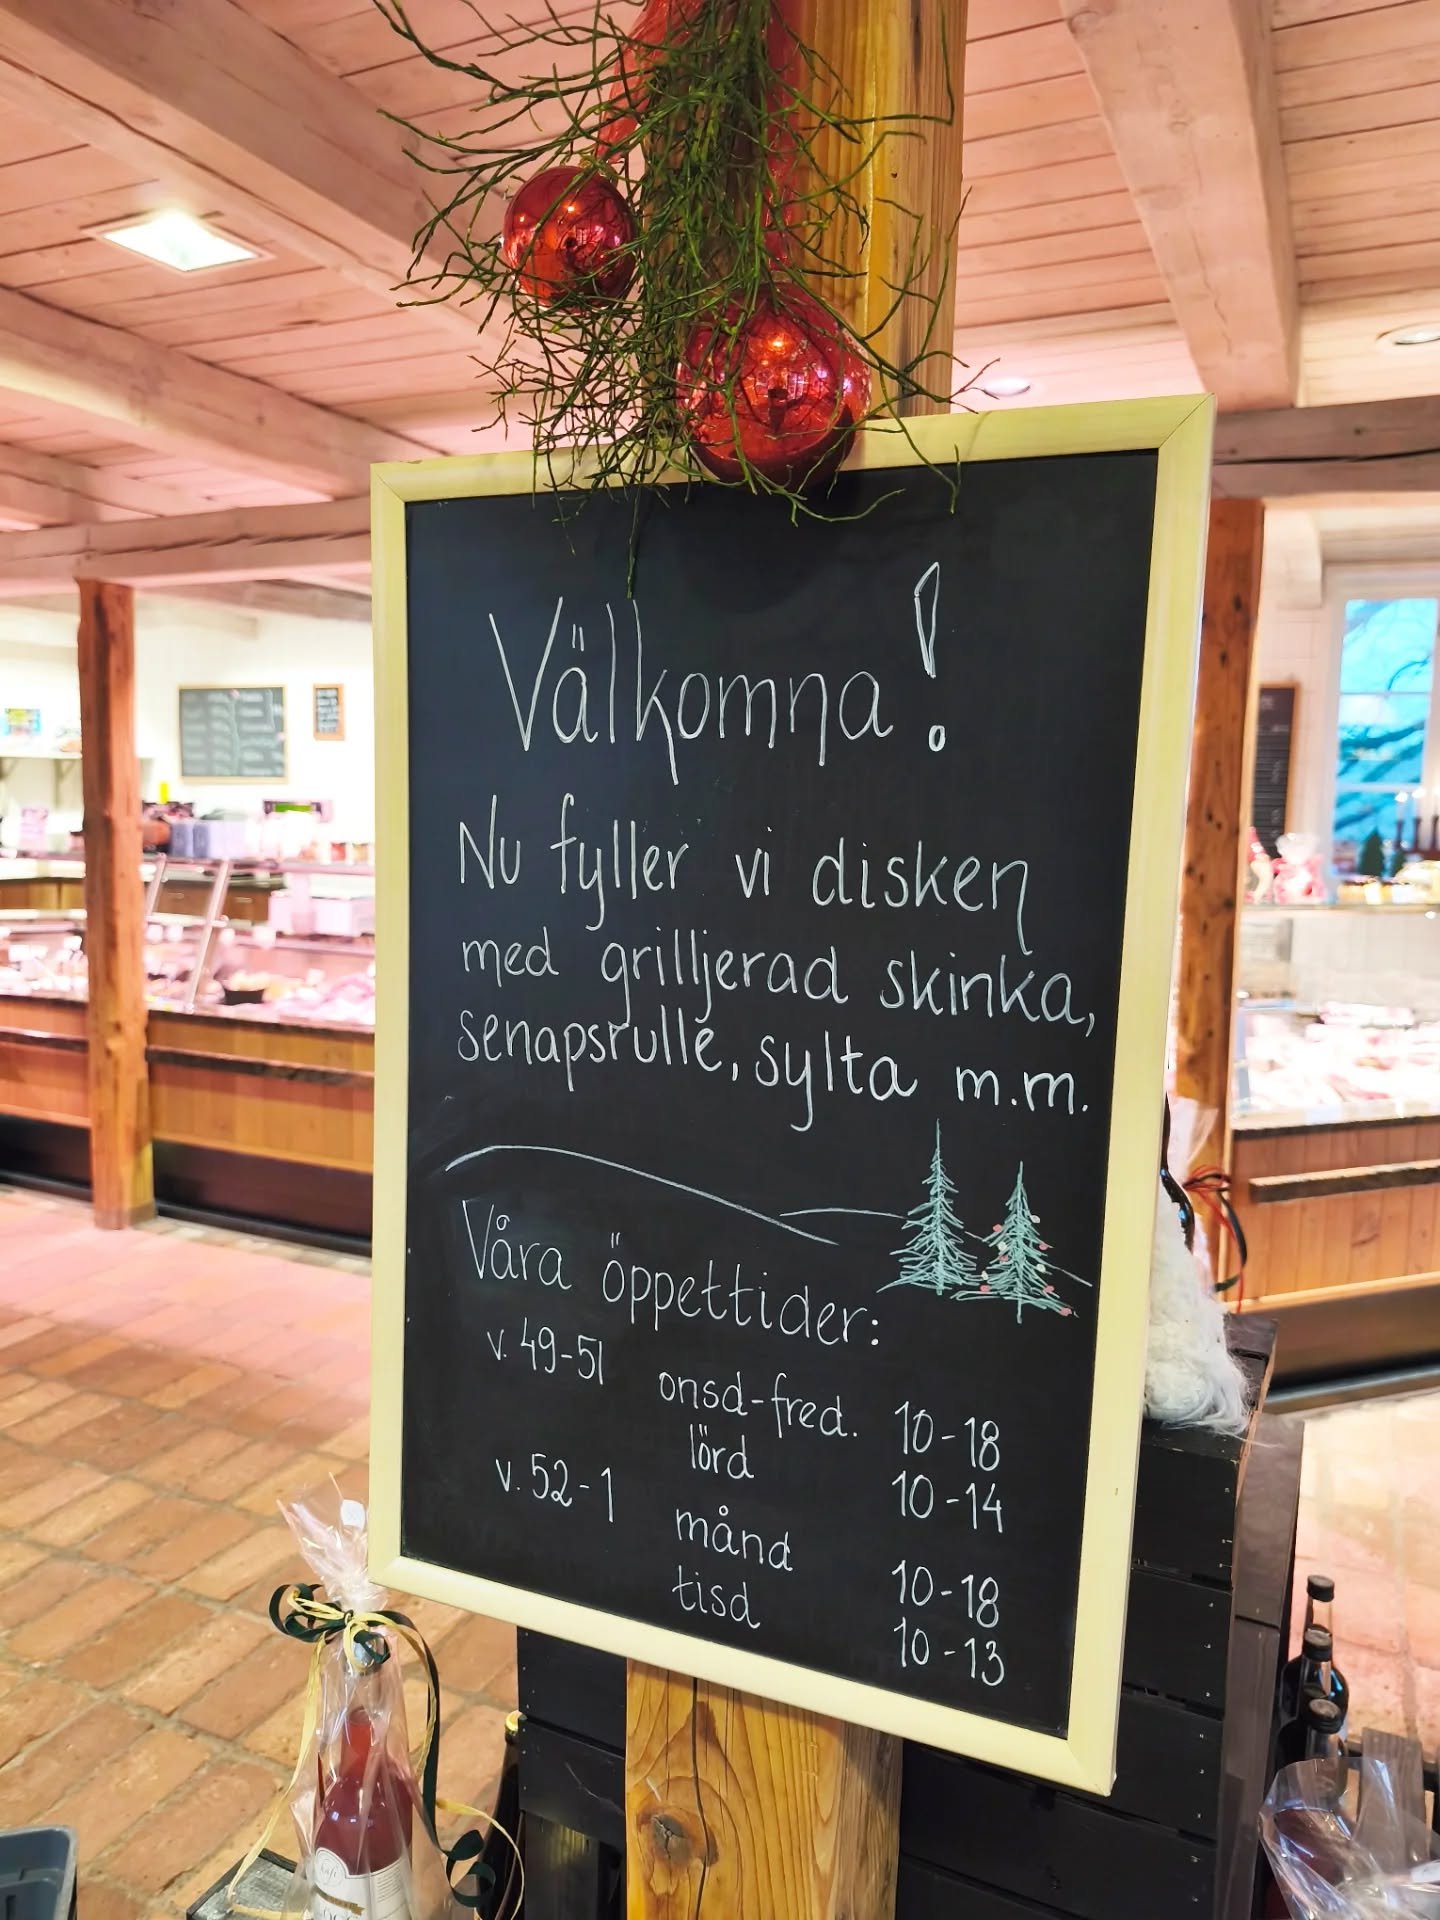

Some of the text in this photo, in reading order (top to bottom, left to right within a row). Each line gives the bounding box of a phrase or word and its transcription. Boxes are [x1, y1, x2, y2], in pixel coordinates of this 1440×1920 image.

[459, 792, 1034, 956] Nu fyller vi disken
[462, 926, 1097, 1039] med grilljerad skinka,
[457, 1004, 1090, 1132] senapsrulle, sylta m.m.
[461, 1199, 880, 1347] Våra öppettider:
[486, 1316, 1001, 1473] v. 49-51 onsd-fred. 10-18
[495, 1452, 1001, 1629] v. 52-1 månd 10-18
[689, 1423, 1004, 1534] lörd 10-14
[671, 1564, 1005, 1688] tisd 10-13
